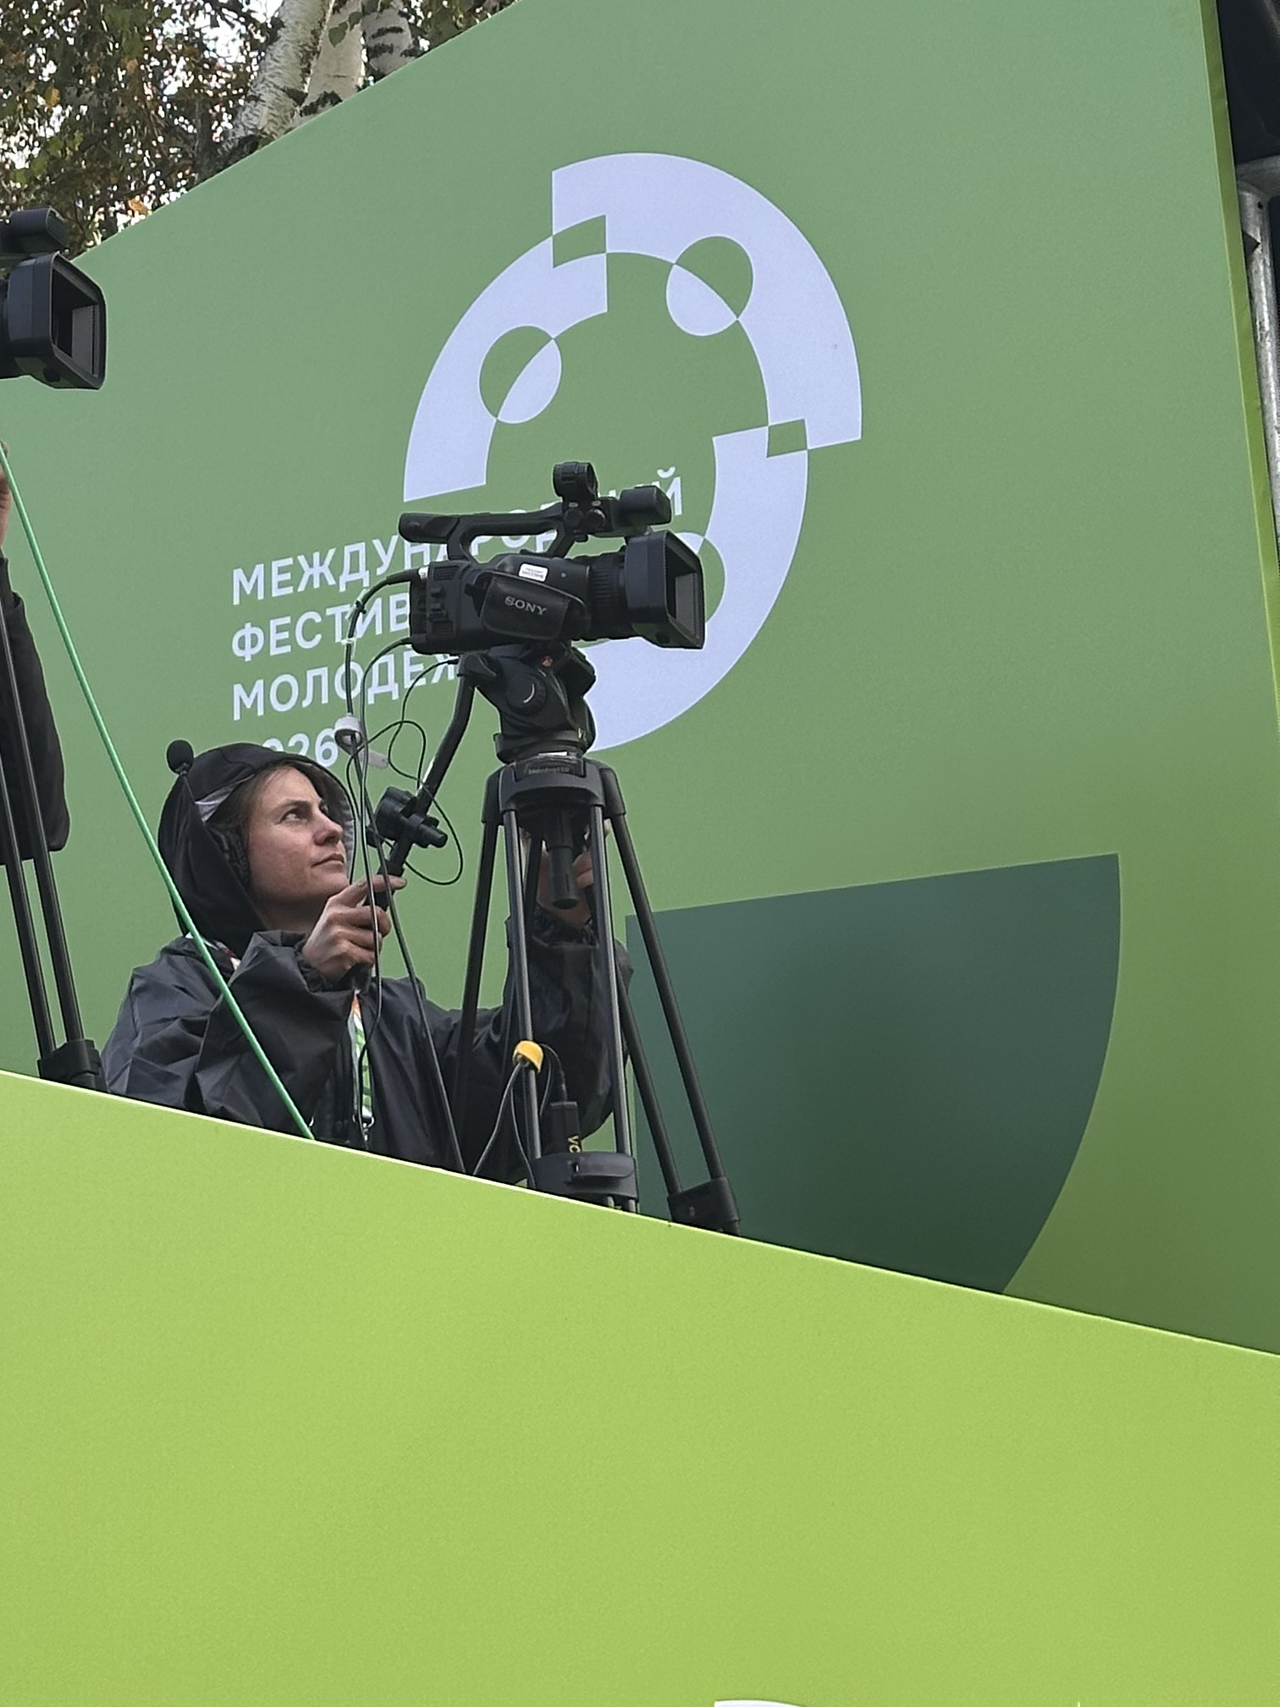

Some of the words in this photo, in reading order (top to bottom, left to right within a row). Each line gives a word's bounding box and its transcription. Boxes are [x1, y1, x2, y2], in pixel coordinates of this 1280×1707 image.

[232, 465, 682, 605] МЕЖДУНЙ
[231, 592, 410, 661] ФЕСТИВ
[504, 595, 548, 615] SONY
[232, 650, 458, 721] МОЛОДЕЖ
